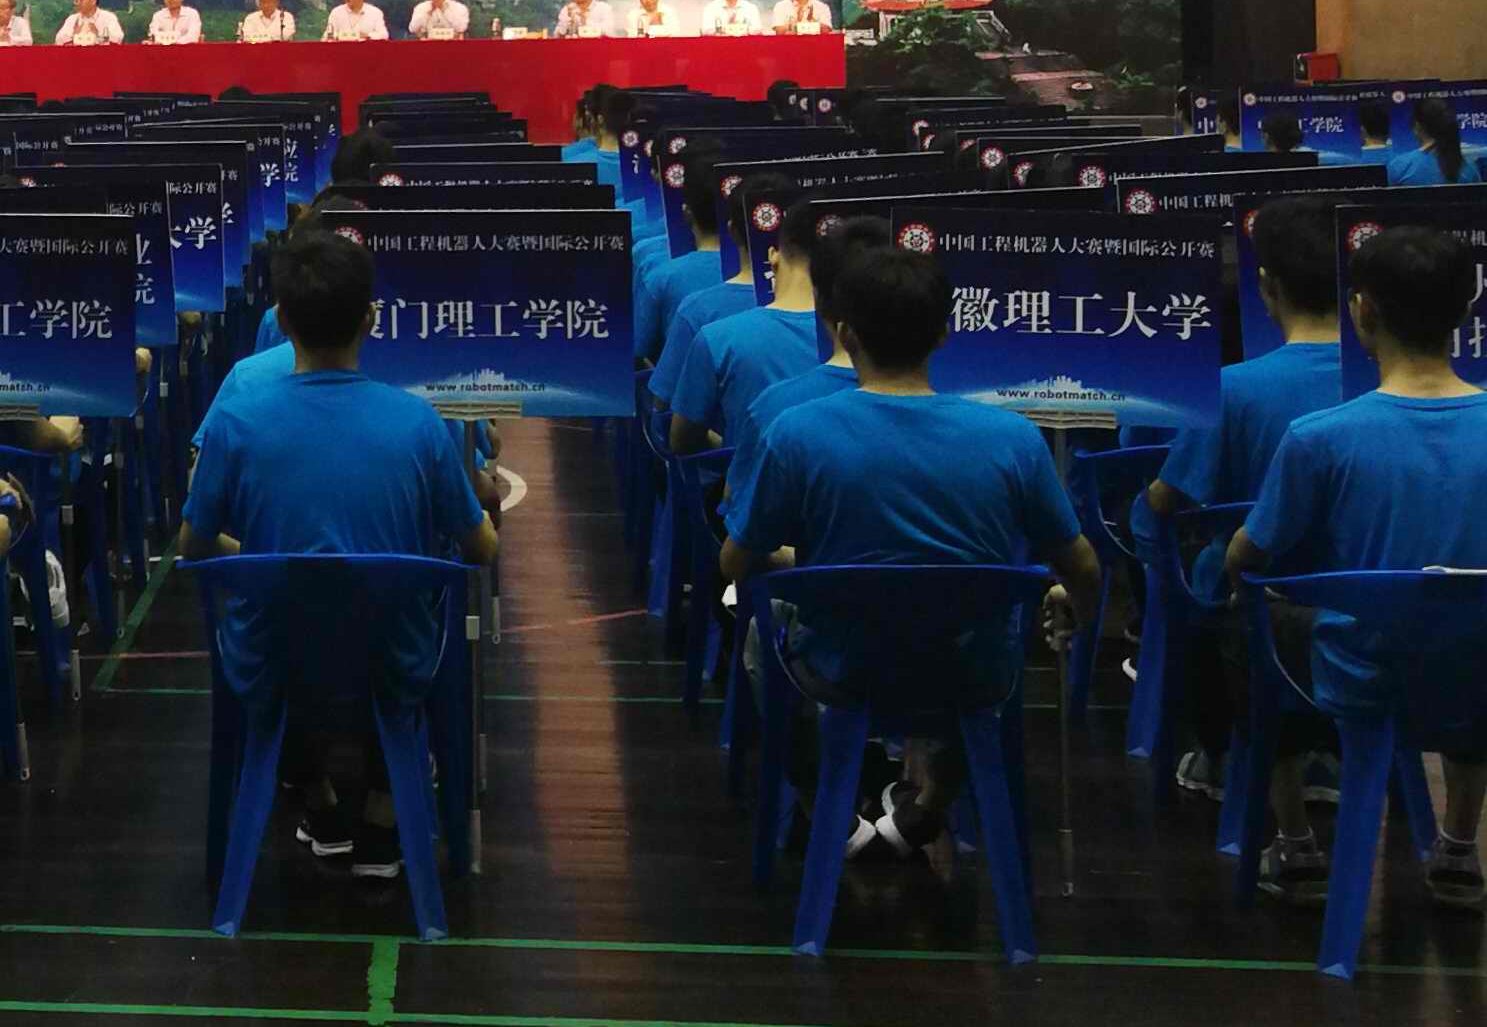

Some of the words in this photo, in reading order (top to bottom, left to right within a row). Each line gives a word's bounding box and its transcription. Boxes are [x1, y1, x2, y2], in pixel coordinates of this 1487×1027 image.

[105, 202, 163, 216] 际公开赛
[367, 233, 625, 253] 中国工程机器人大赛暨国际公开赛
[939, 232, 1217, 259] 中国工程机器人大赛暨国际公开赛
[948, 286, 1213, 340] 徽理工大学
[425, 382, 545, 393] www.robotmatch.cn
[996, 387, 1126, 402] www.robotmatch.cn
